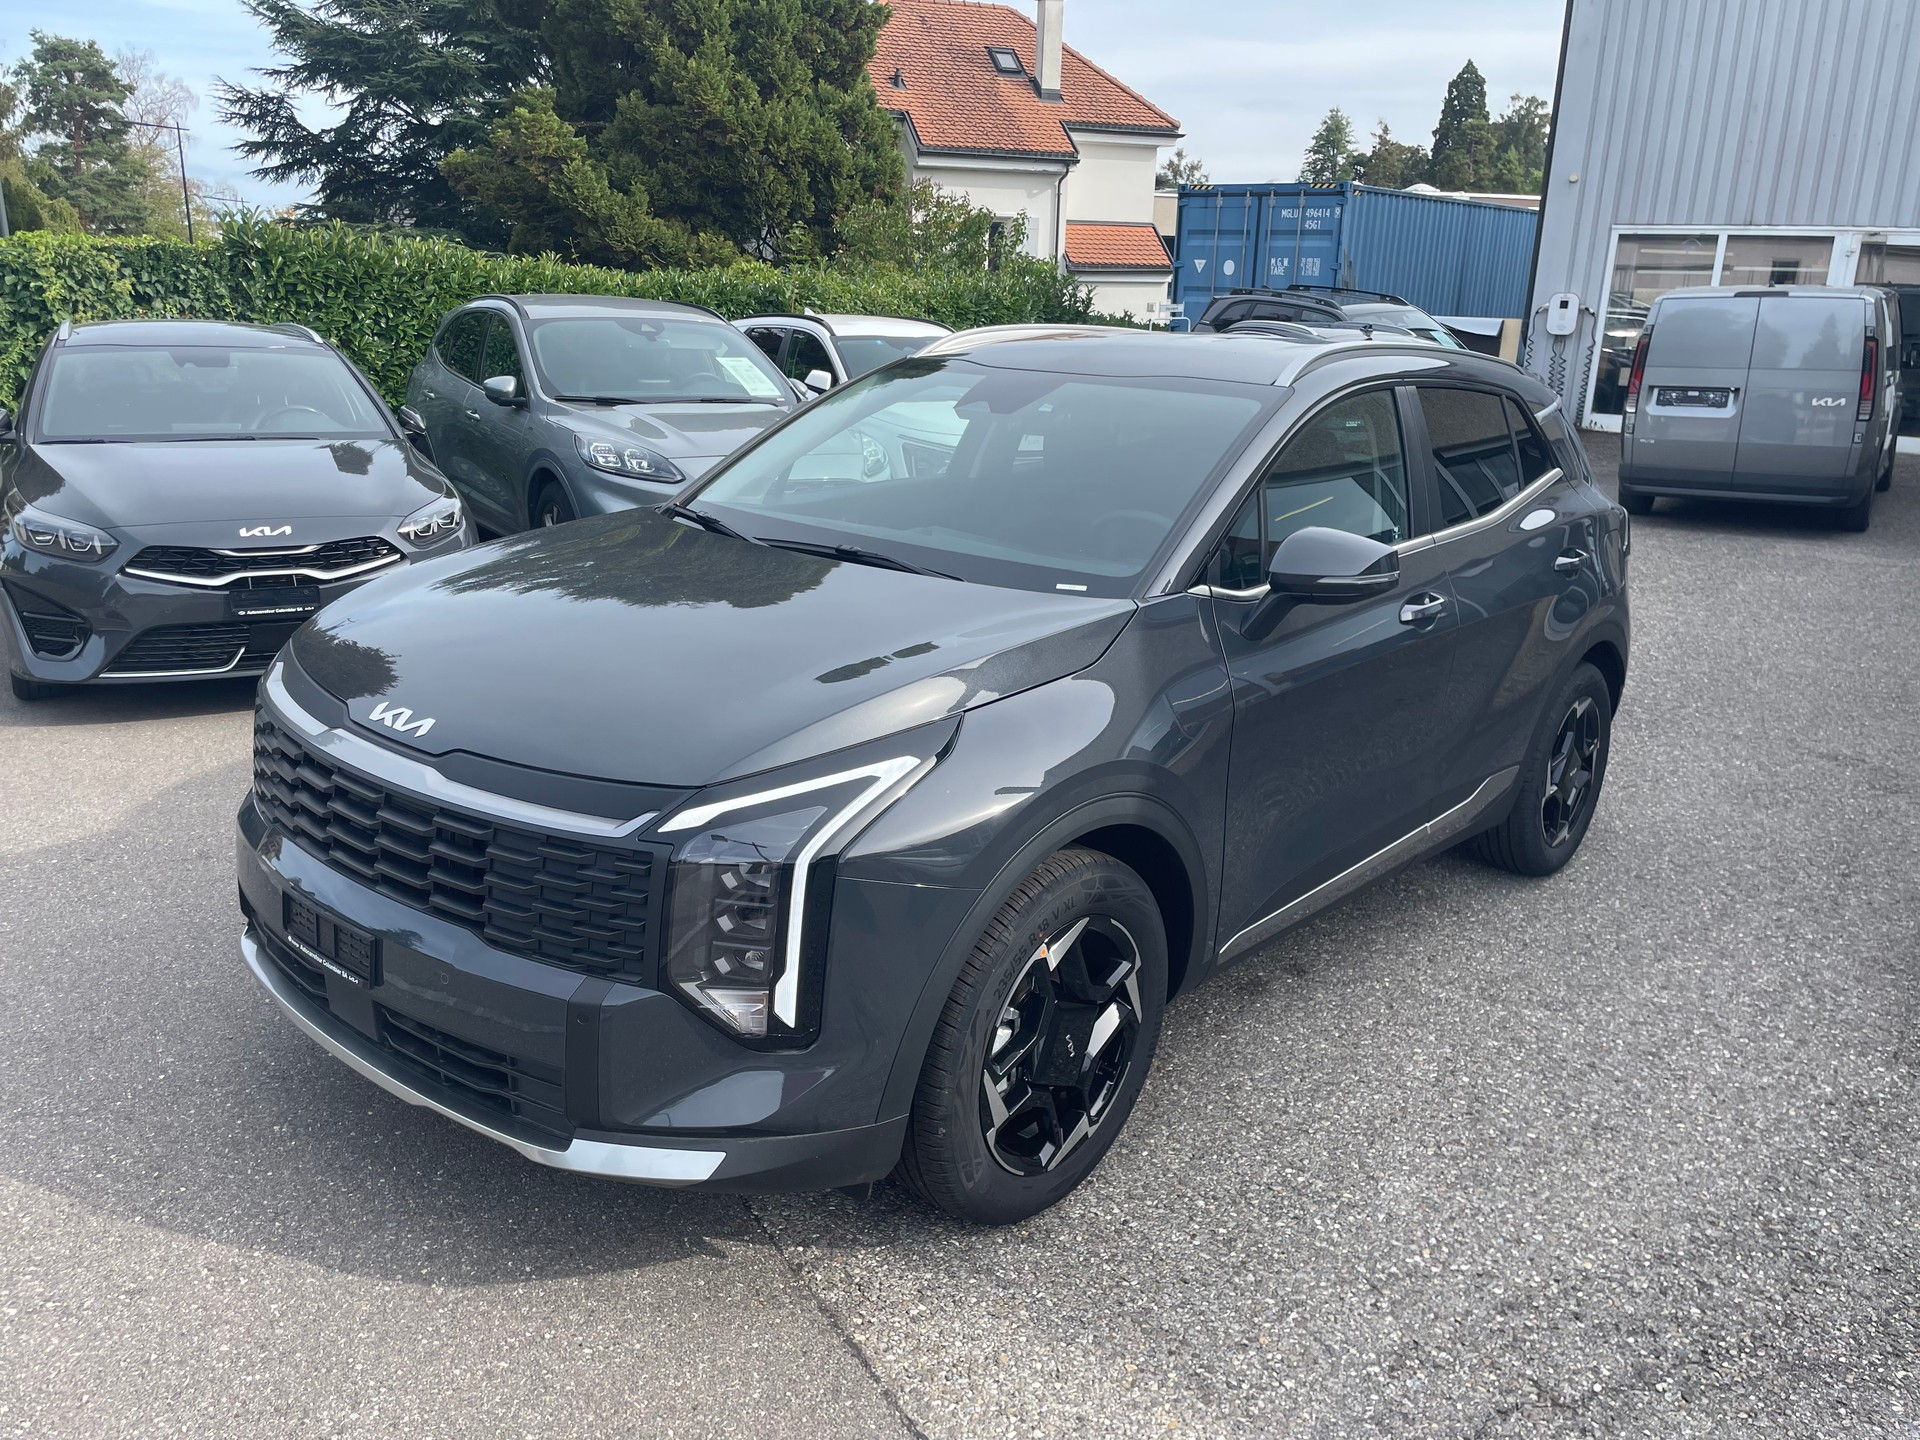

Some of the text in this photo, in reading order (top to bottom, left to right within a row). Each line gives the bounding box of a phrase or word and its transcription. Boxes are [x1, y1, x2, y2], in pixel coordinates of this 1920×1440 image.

[1281, 208, 1299, 219] MGLU
[1305, 208, 1331, 218] 496414
[1304, 220, 1321, 230] 45G1
[1270, 266, 1286, 276] TARE
[1811, 397, 1846, 407] KIA
[239, 525, 292, 537] KIA
[368, 701, 436, 738] KIA
[993, 946, 1028, 999] 235/55
[1028, 931, 1039, 947] R
[1051, 906, 1061, 920] V
[1063, 896, 1077, 914] XL
